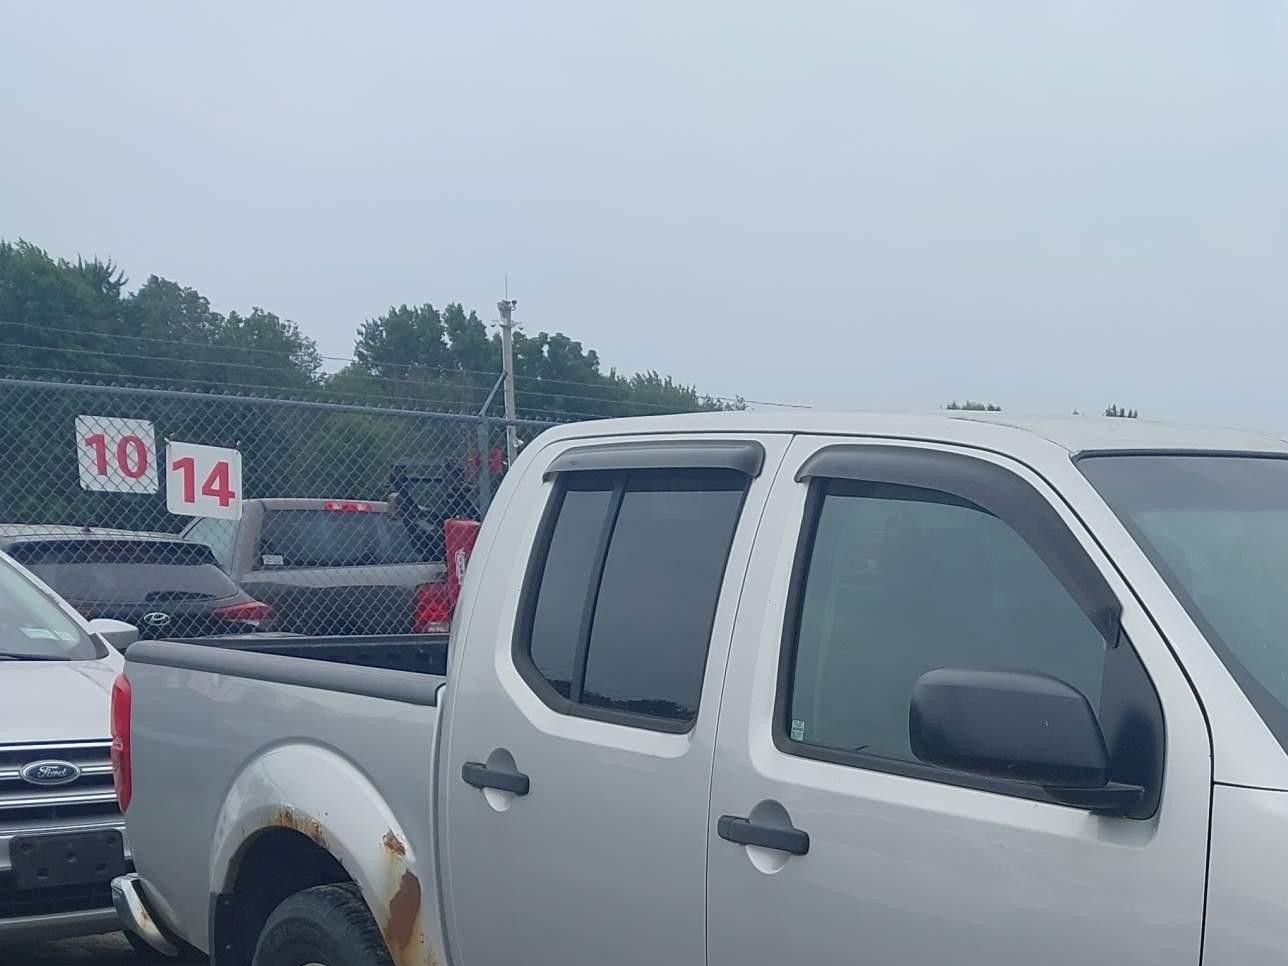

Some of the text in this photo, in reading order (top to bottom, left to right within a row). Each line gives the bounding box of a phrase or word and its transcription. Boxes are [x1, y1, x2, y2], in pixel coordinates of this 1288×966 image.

[84, 433, 148, 480] 10
[172, 457, 236, 508] 14
[37, 765, 67, 778] Ford
